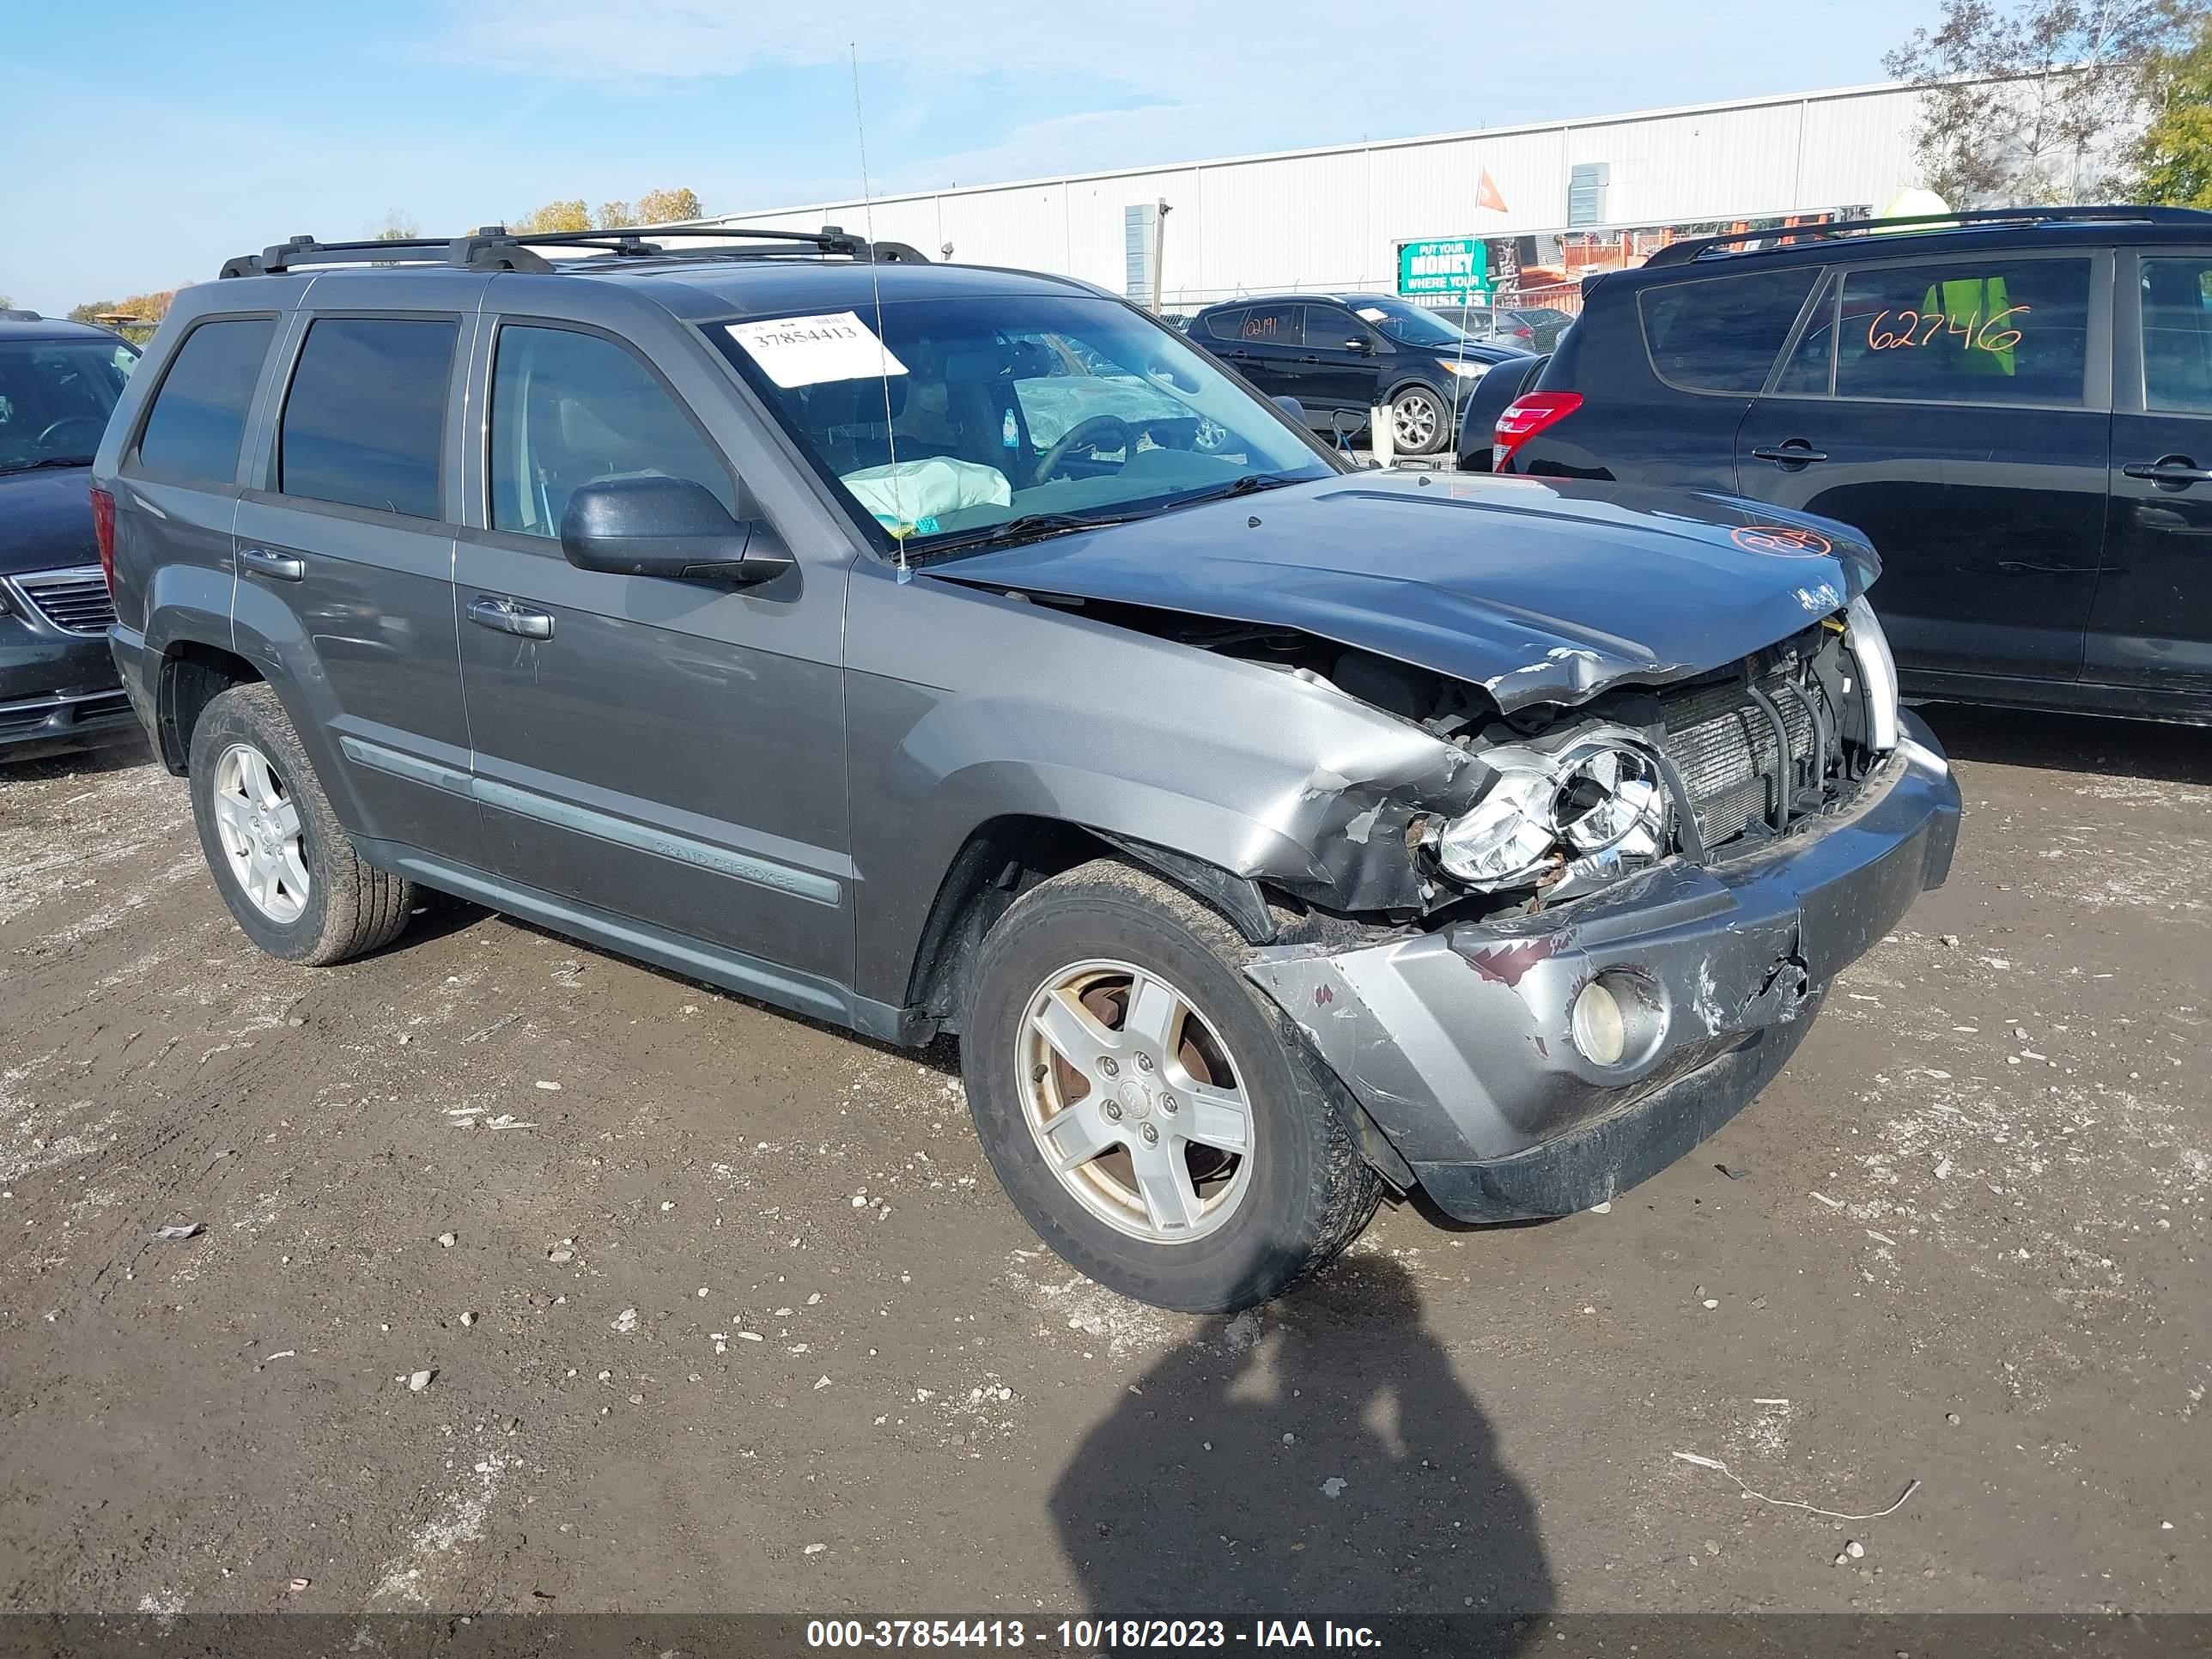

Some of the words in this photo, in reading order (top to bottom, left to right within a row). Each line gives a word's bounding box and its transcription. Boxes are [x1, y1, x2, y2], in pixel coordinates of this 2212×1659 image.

[1419, 244, 1438, 256] PUT
[1437, 242, 1465, 255] YOUR
[1411, 253, 1474, 276] MONEY
[1407, 276, 1448, 289] WHERE
[1449, 275, 1480, 289] YOUR
[753, 326, 857, 348] 37854413
[1869, 306, 2032, 351] 62746
[656, 841, 709, 865] GRAND
[714, 857, 798, 890] CHEROKEE
